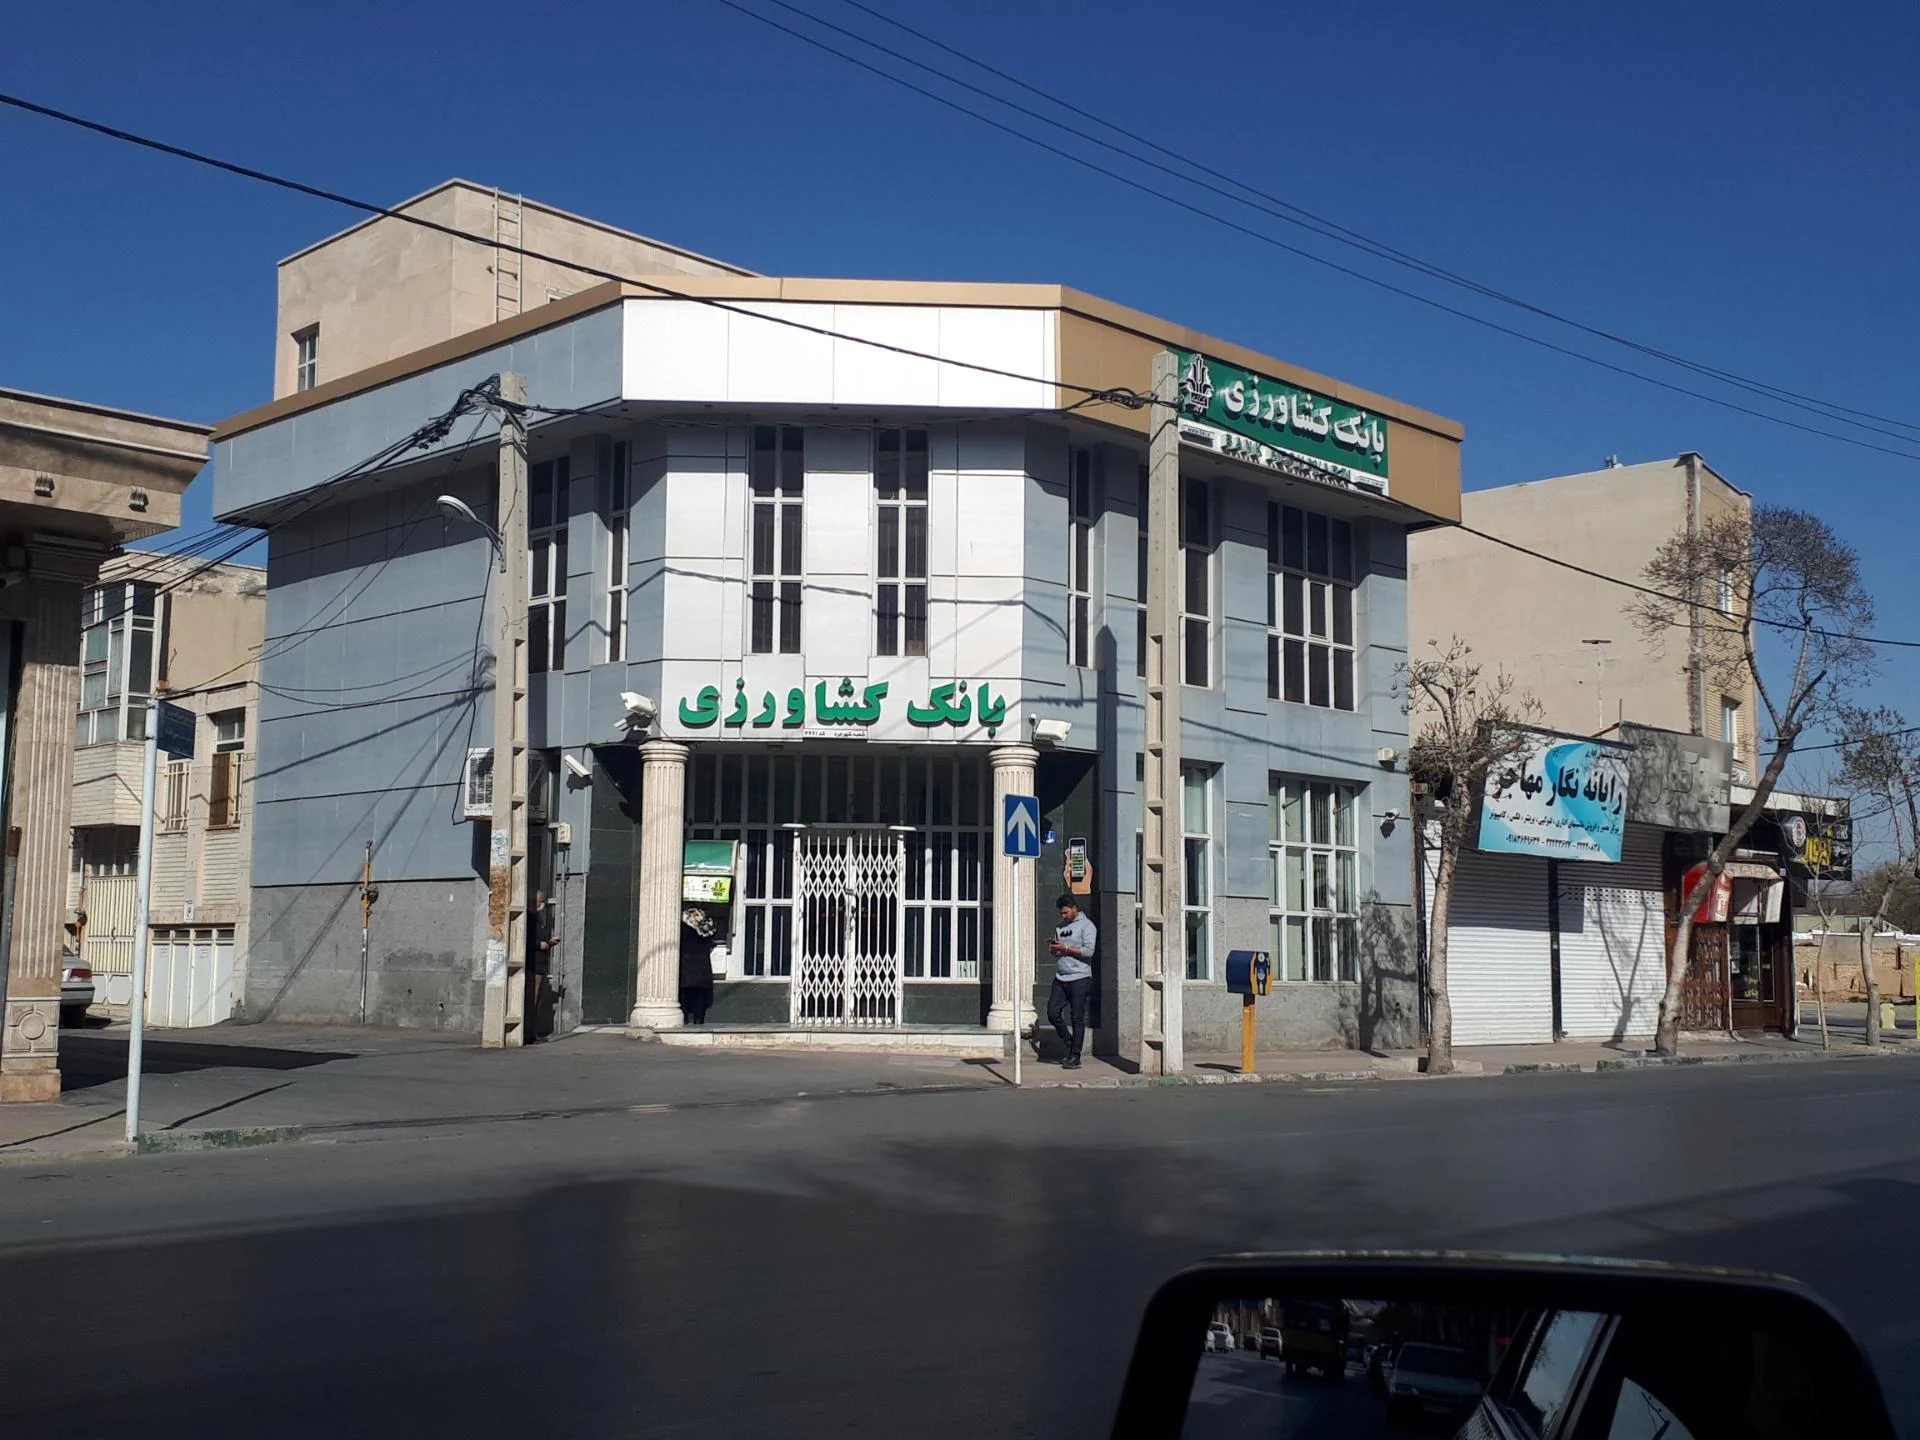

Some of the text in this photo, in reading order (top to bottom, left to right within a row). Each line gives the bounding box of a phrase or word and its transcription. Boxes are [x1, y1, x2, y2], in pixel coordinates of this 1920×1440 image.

[1222, 376, 1385, 463] بانک کشاورزی
[1222, 433, 1262, 457] BANK
[678, 676, 1007, 739] بانک کشاورزی
[1492, 759, 1543, 802] مهاجر
[1545, 765, 1580, 806] نگار
[1583, 771, 1622, 815] رایانه
